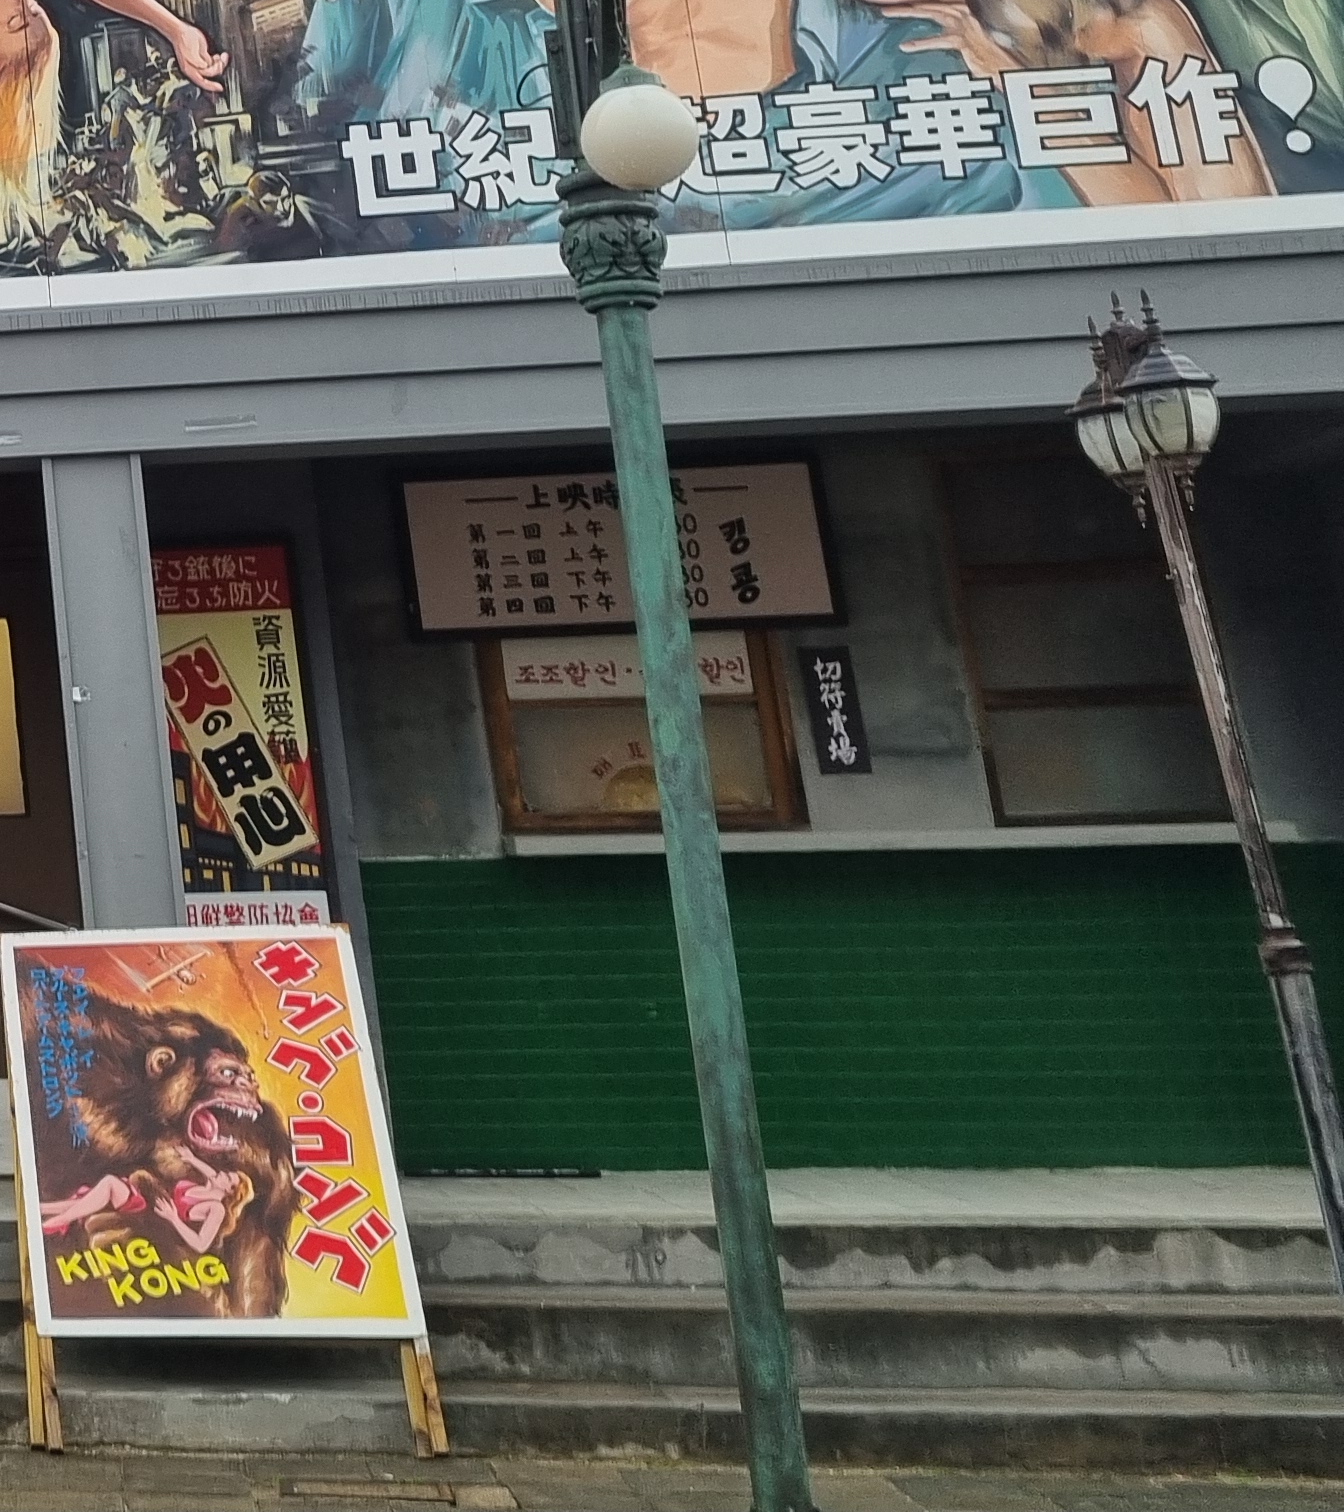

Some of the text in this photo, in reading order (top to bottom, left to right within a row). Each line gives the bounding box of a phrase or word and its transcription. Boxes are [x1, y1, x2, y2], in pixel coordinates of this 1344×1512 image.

[340, 54, 1316, 218] 世紀超豪華巨作!
[56, 1238, 160, 1286] KING
[107, 1254, 230, 1308] KONG
